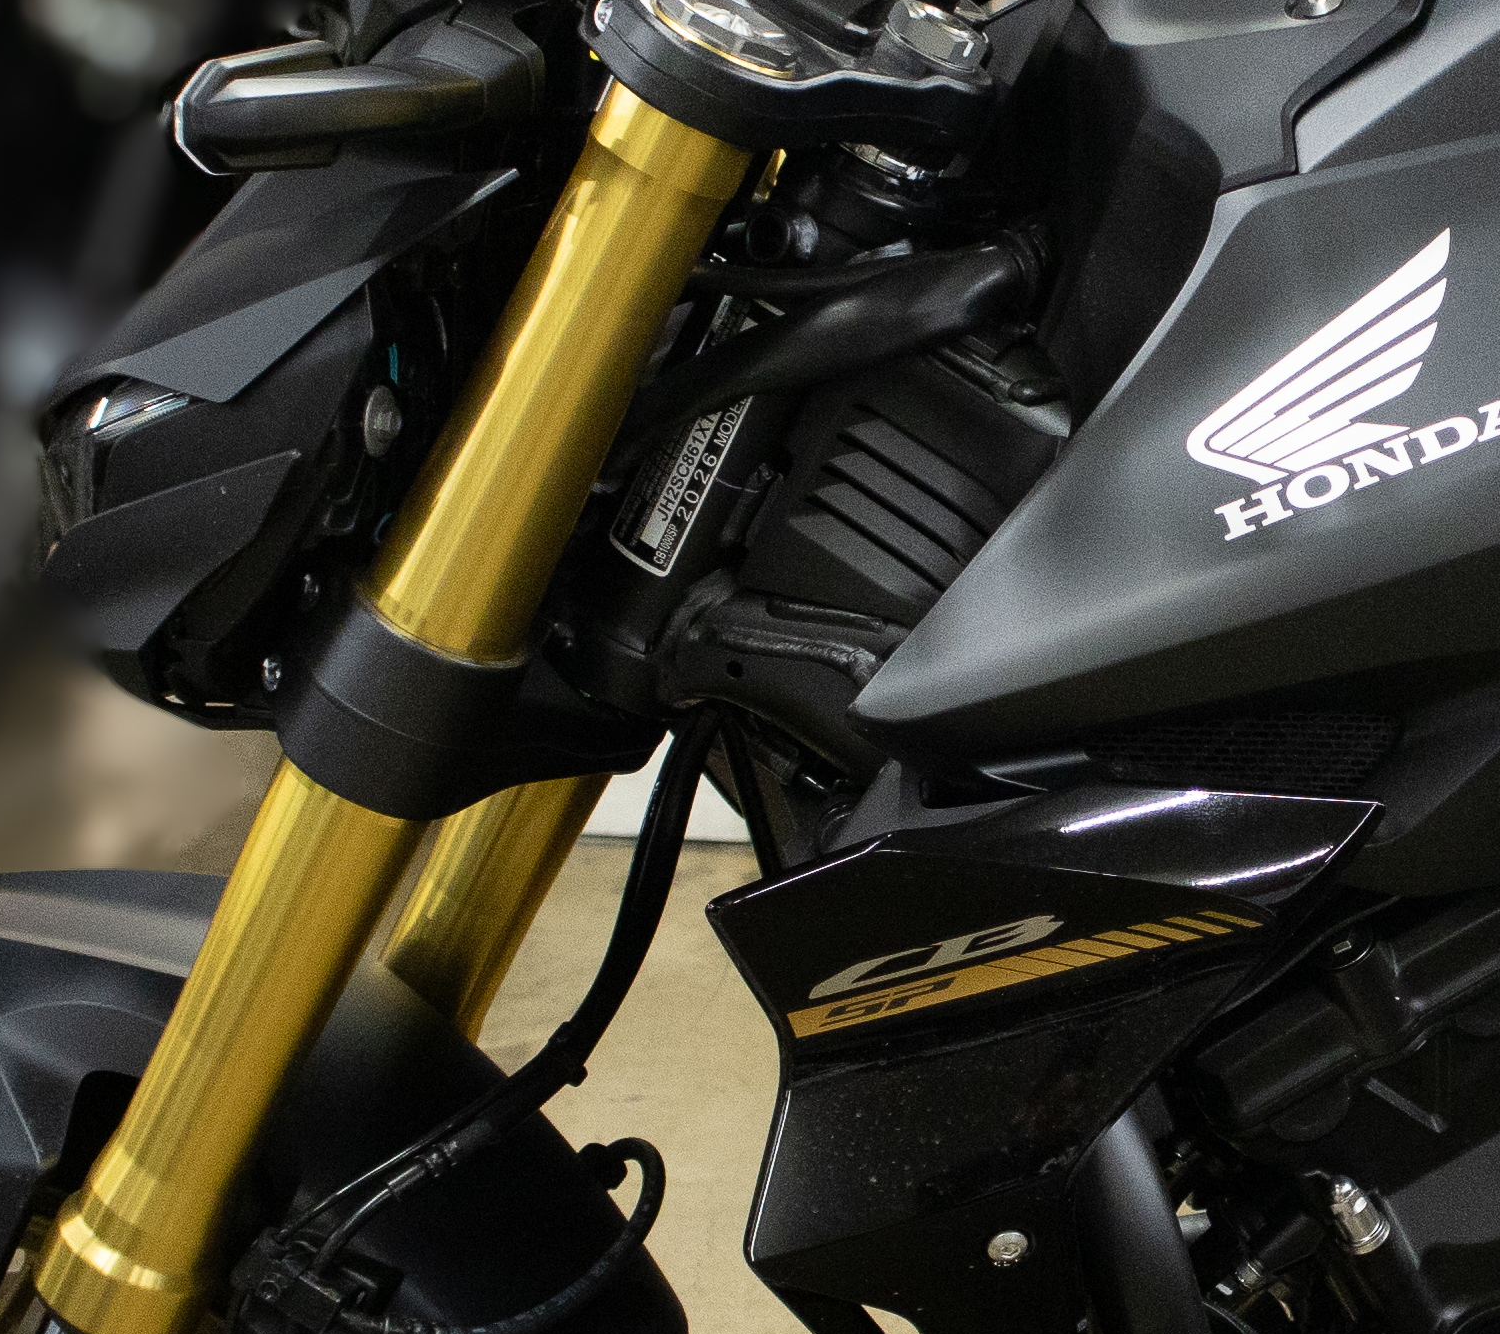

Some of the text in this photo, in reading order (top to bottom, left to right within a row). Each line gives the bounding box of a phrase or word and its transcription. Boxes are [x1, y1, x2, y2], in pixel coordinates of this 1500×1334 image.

[652, 522, 678, 566] CB1000SP
[809, 914, 1064, 1000] CB
[818, 975, 958, 1032] SP
